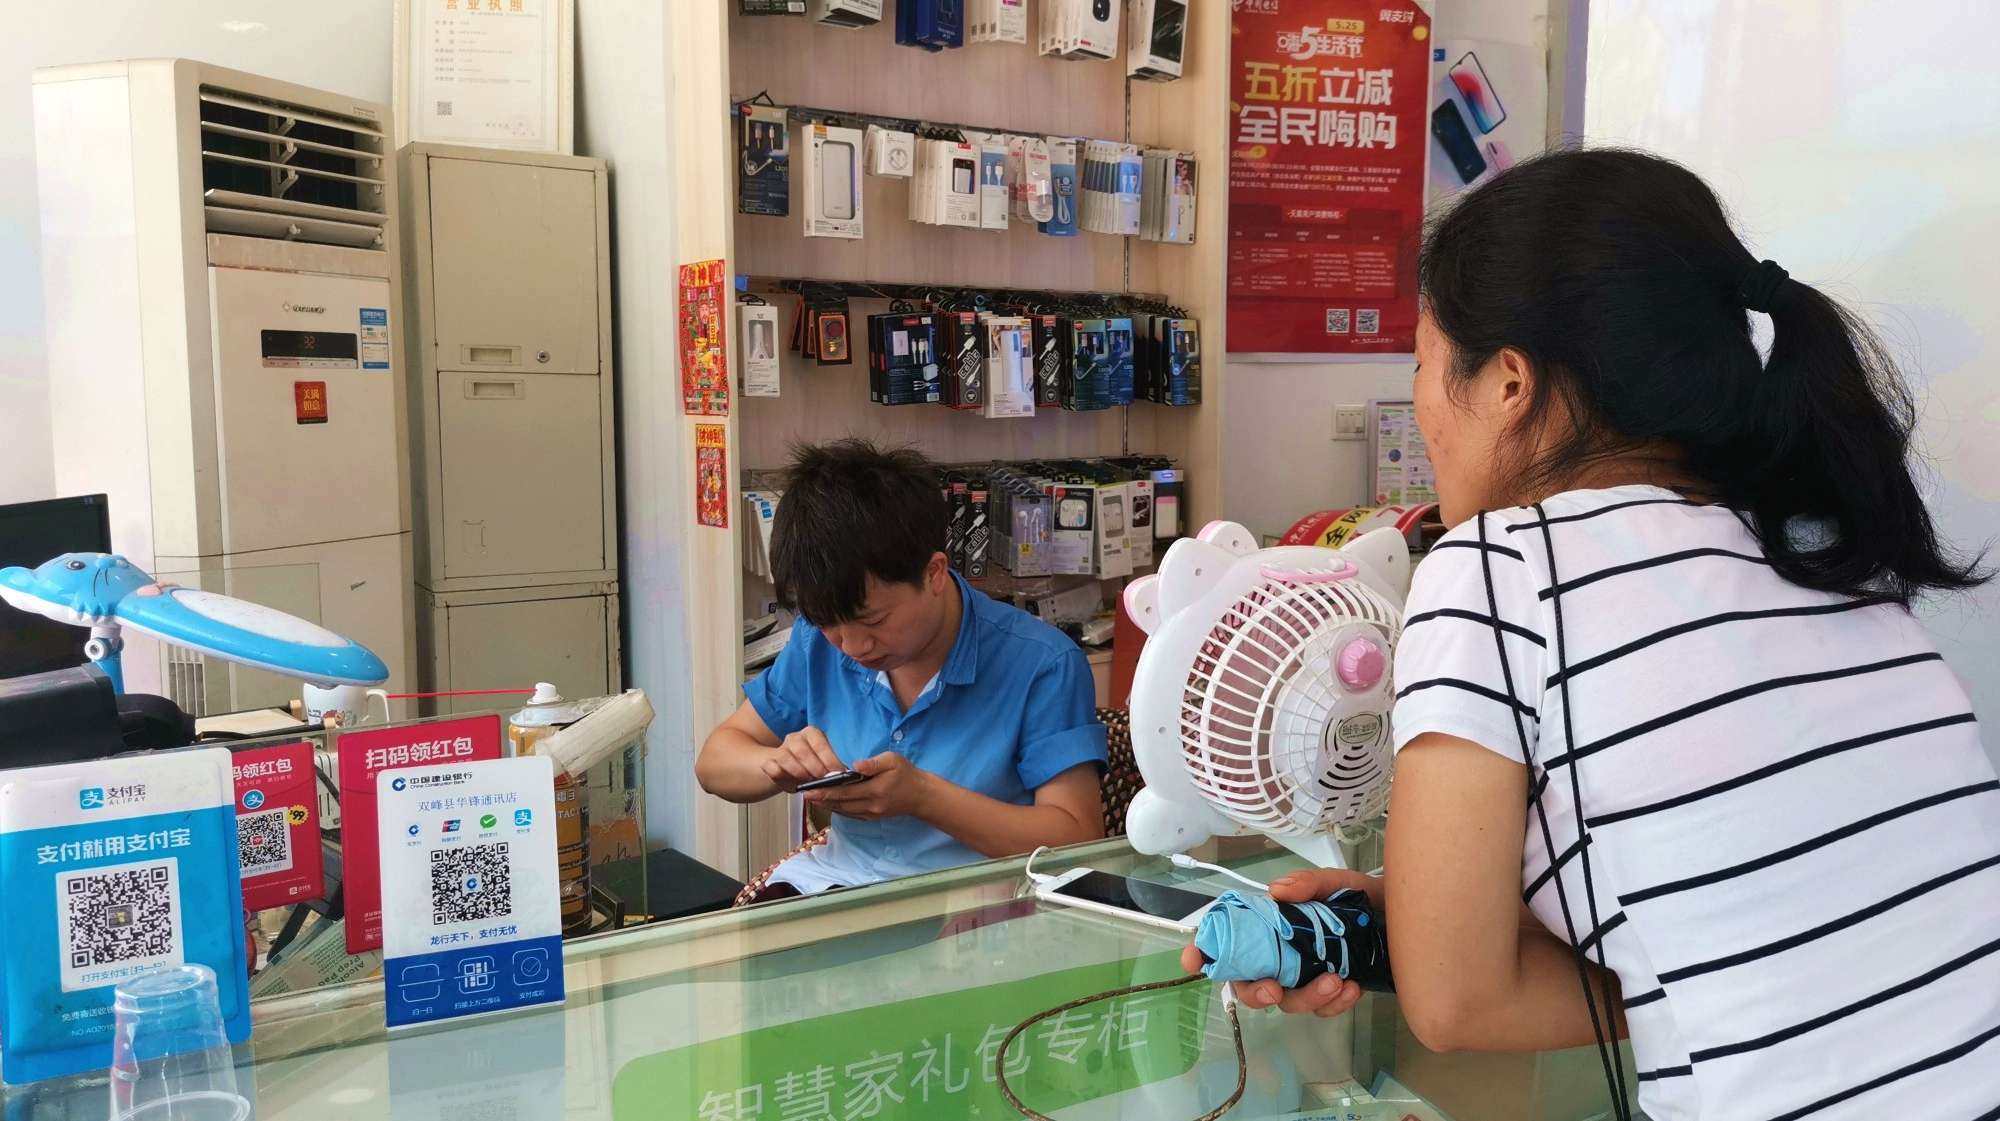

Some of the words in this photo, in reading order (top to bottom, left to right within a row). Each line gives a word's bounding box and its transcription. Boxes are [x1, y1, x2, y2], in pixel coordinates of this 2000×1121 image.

[1335, 21, 1358, 30] 5.25
[1244, 61, 1393, 105] 五折立减
[1237, 105, 1397, 150] 全民嗨购
[957, 348, 981, 380] cable
[365, 736, 474, 769] 扫码领红包
[409, 771, 473, 785] 中国建设银行
[106, 784, 147, 799] 支付宝
[109, 795, 147, 806] ALIPAY
[418, 791, 518, 812] 双峰县华锋通讯店
[36, 828, 192, 865] 支付就用支付宝
[430, 925, 518, 946] 龙行天下，支付无忧
